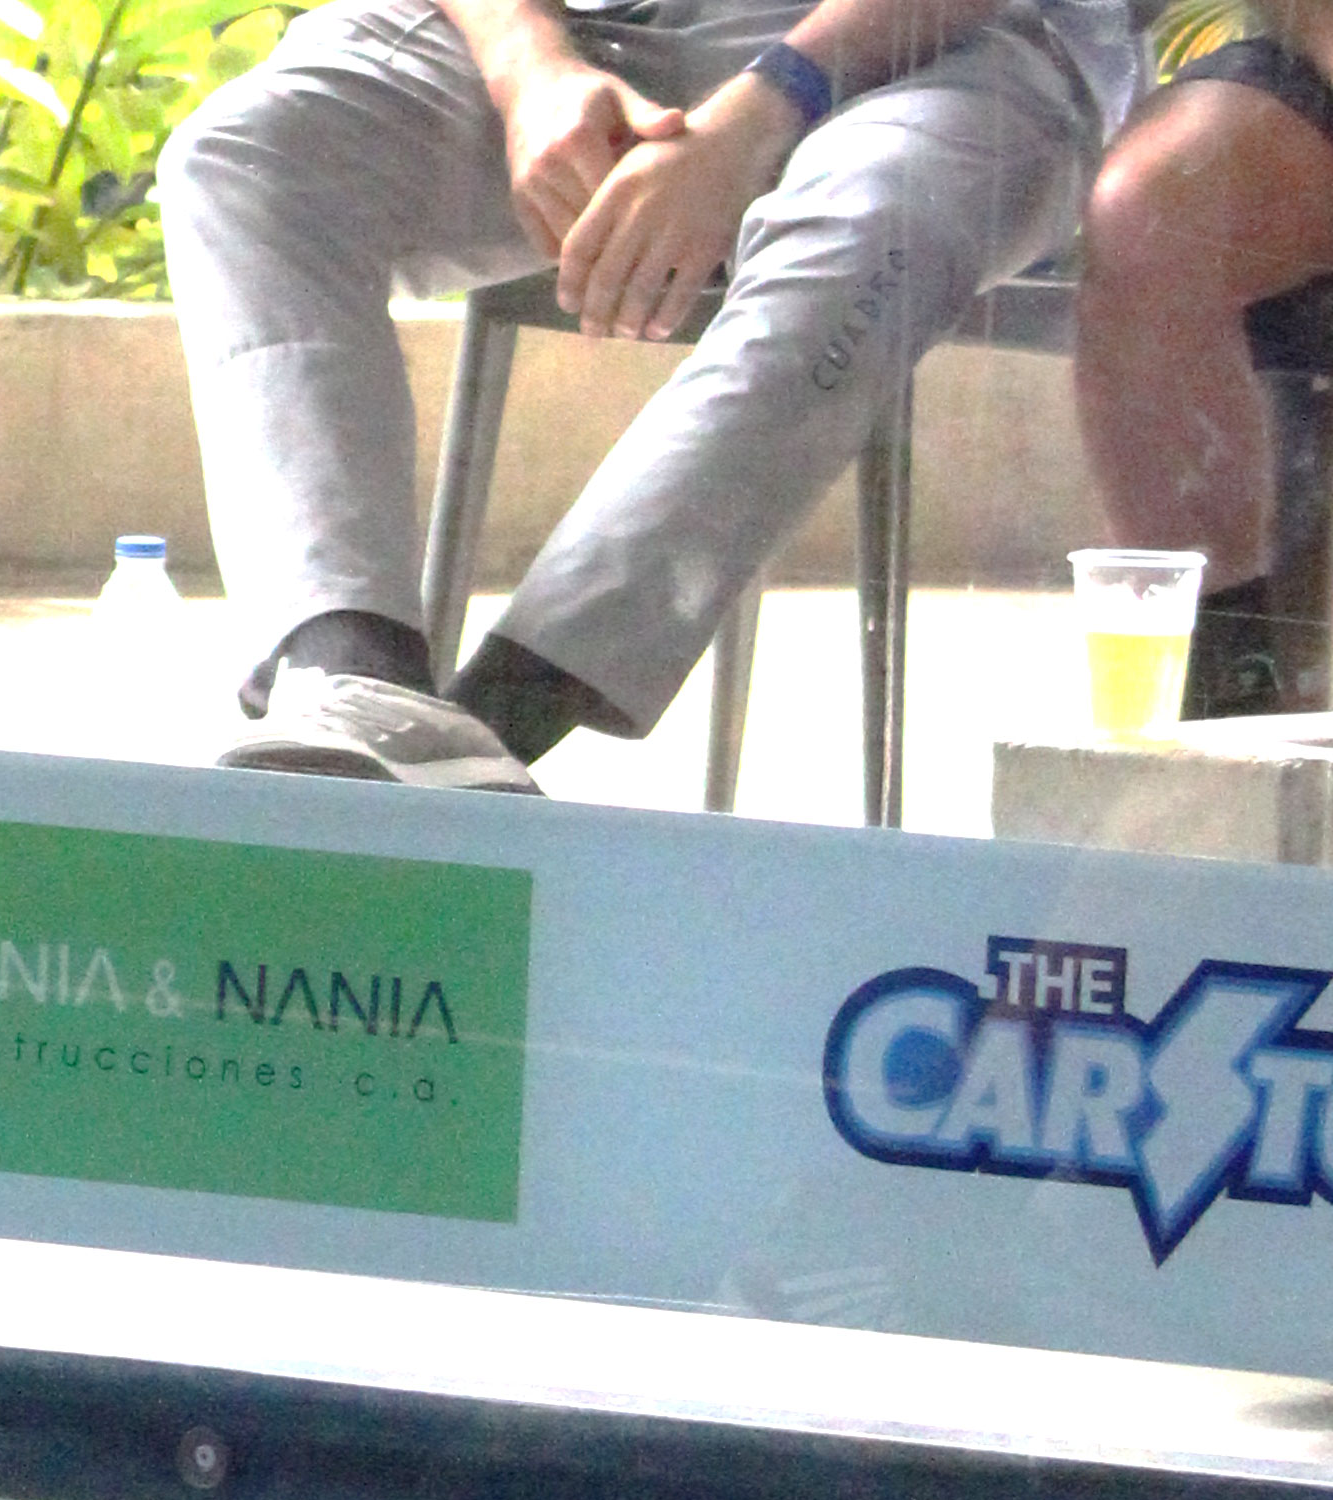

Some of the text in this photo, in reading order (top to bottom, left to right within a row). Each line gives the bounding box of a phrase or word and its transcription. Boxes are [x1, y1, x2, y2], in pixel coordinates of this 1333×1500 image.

[144, 959, 184, 1018] &
[216, 960, 457, 1045] NANIA
[998, 950, 1117, 1015] THE
[353, 1067, 459, 1106] c.a.
[830, 975, 1333, 1245] CARST
